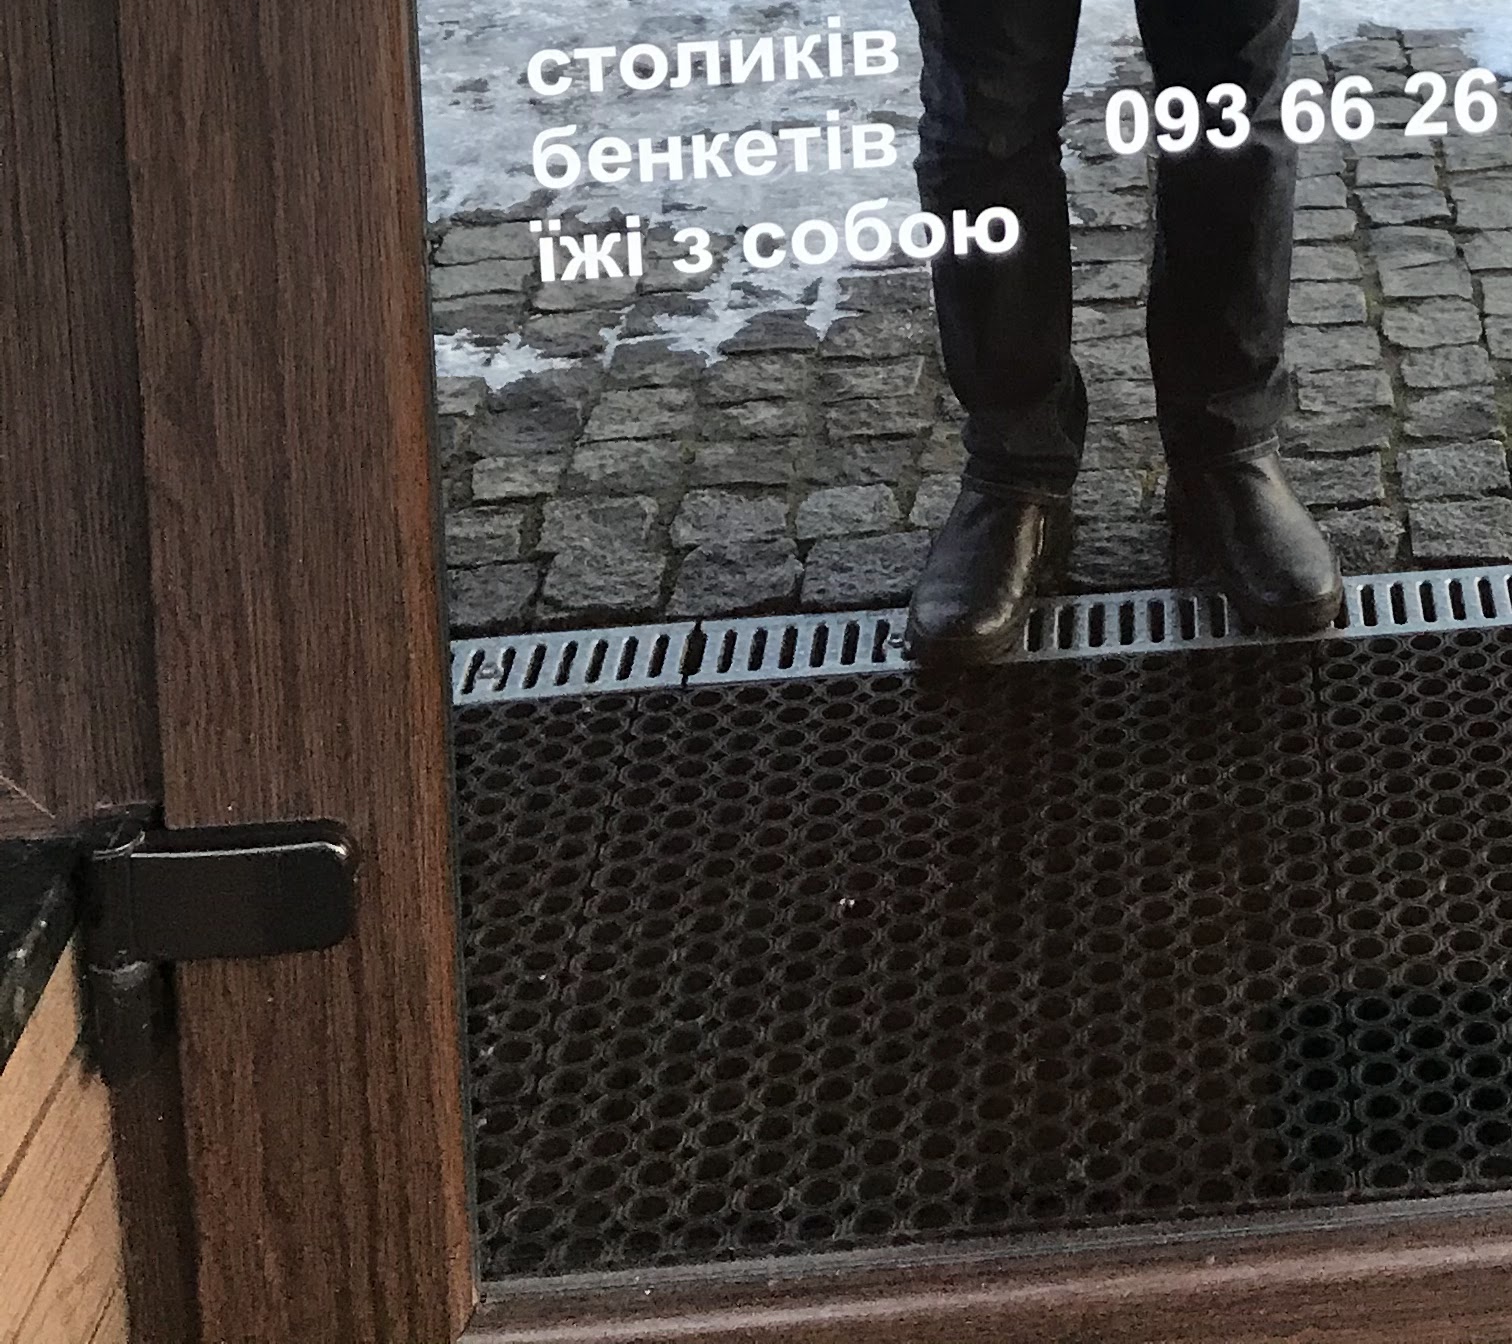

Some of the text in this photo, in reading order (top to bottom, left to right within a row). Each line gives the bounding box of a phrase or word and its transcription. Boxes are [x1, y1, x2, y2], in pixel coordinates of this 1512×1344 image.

[525, 15, 900, 97] столиків
[531, 108, 898, 190] бенкетів
[1104, 81, 1252, 155] 093
[1280, 74, 1376, 145] 66
[1402, 66, 1499, 138] 26
[528, 196, 1021, 283] їжі з собою
